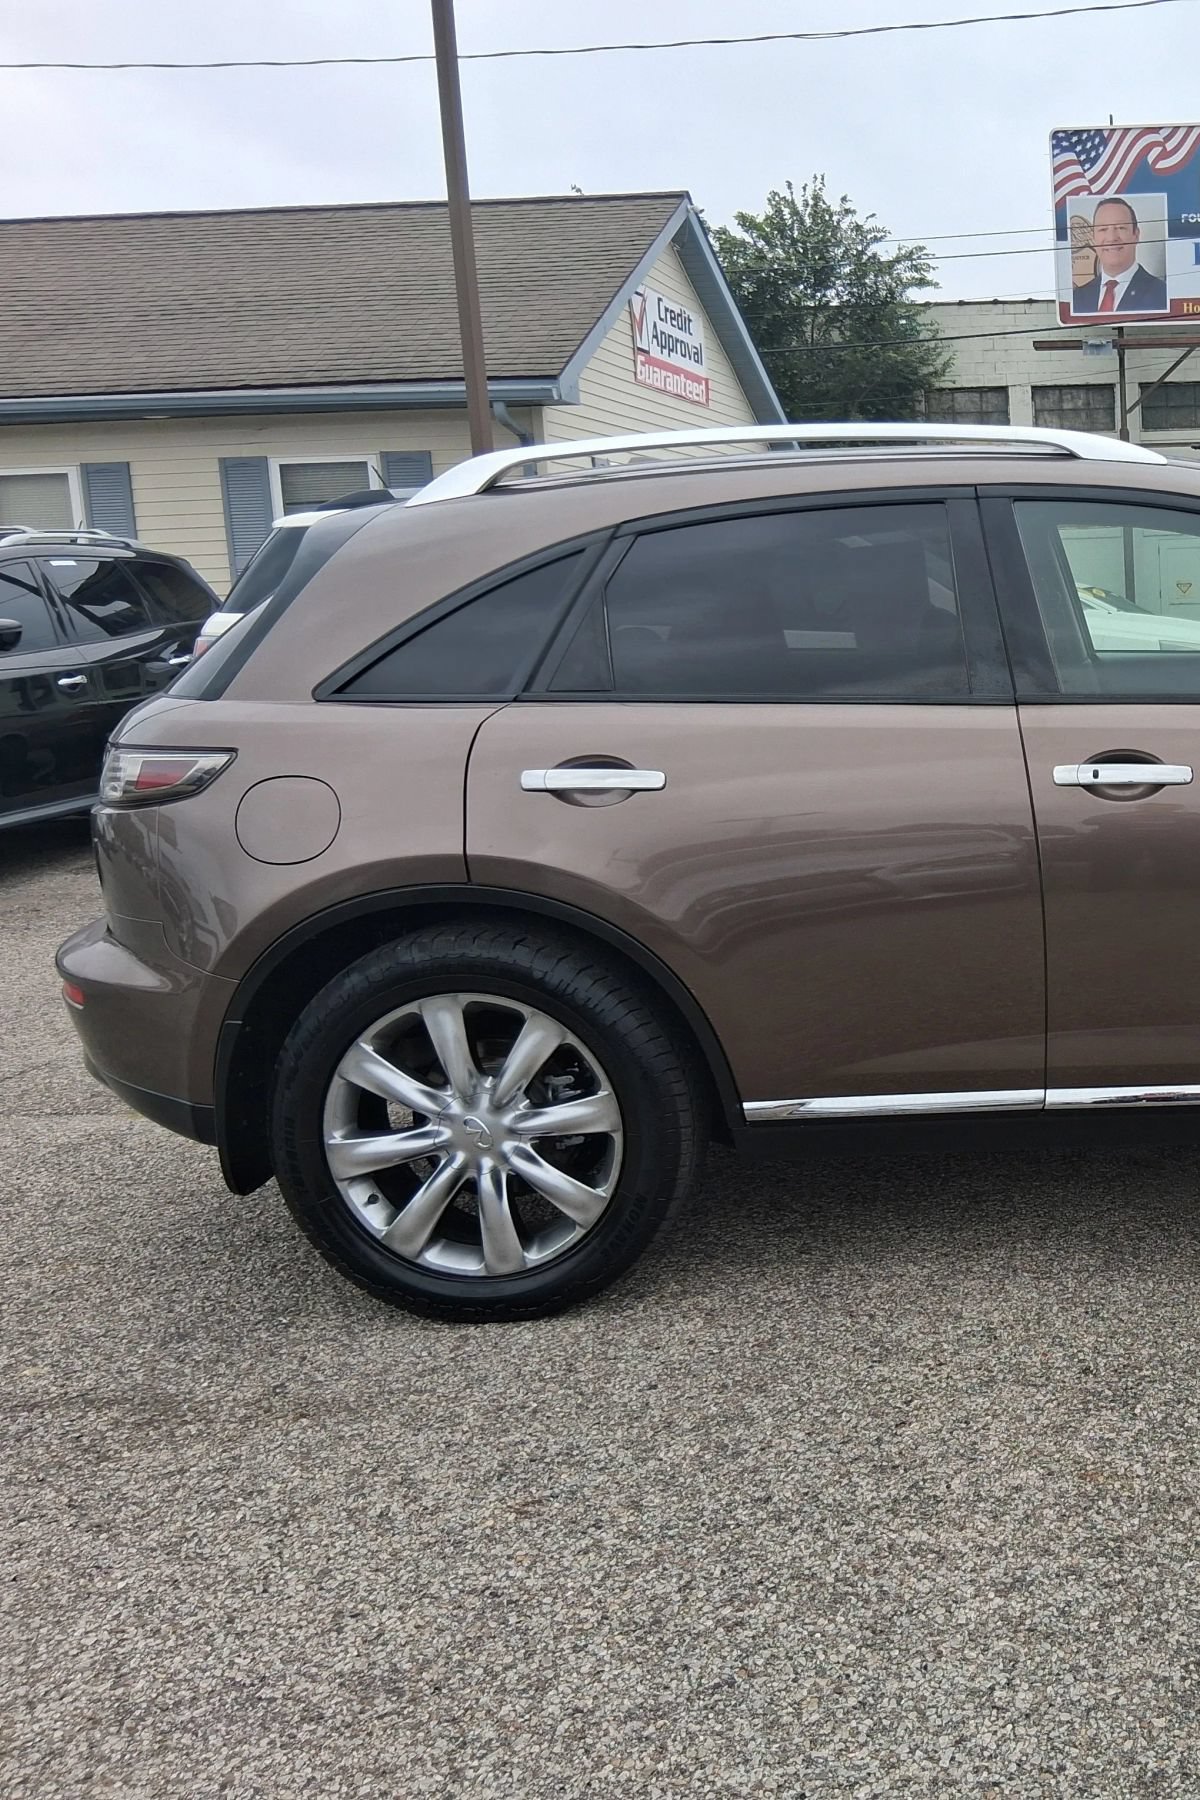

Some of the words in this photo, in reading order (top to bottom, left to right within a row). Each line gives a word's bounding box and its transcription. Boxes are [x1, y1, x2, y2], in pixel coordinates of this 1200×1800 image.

[657, 297, 693, 336] Credit
[651, 321, 703, 366] Approval
[637, 355, 706, 404] Guaranteed
